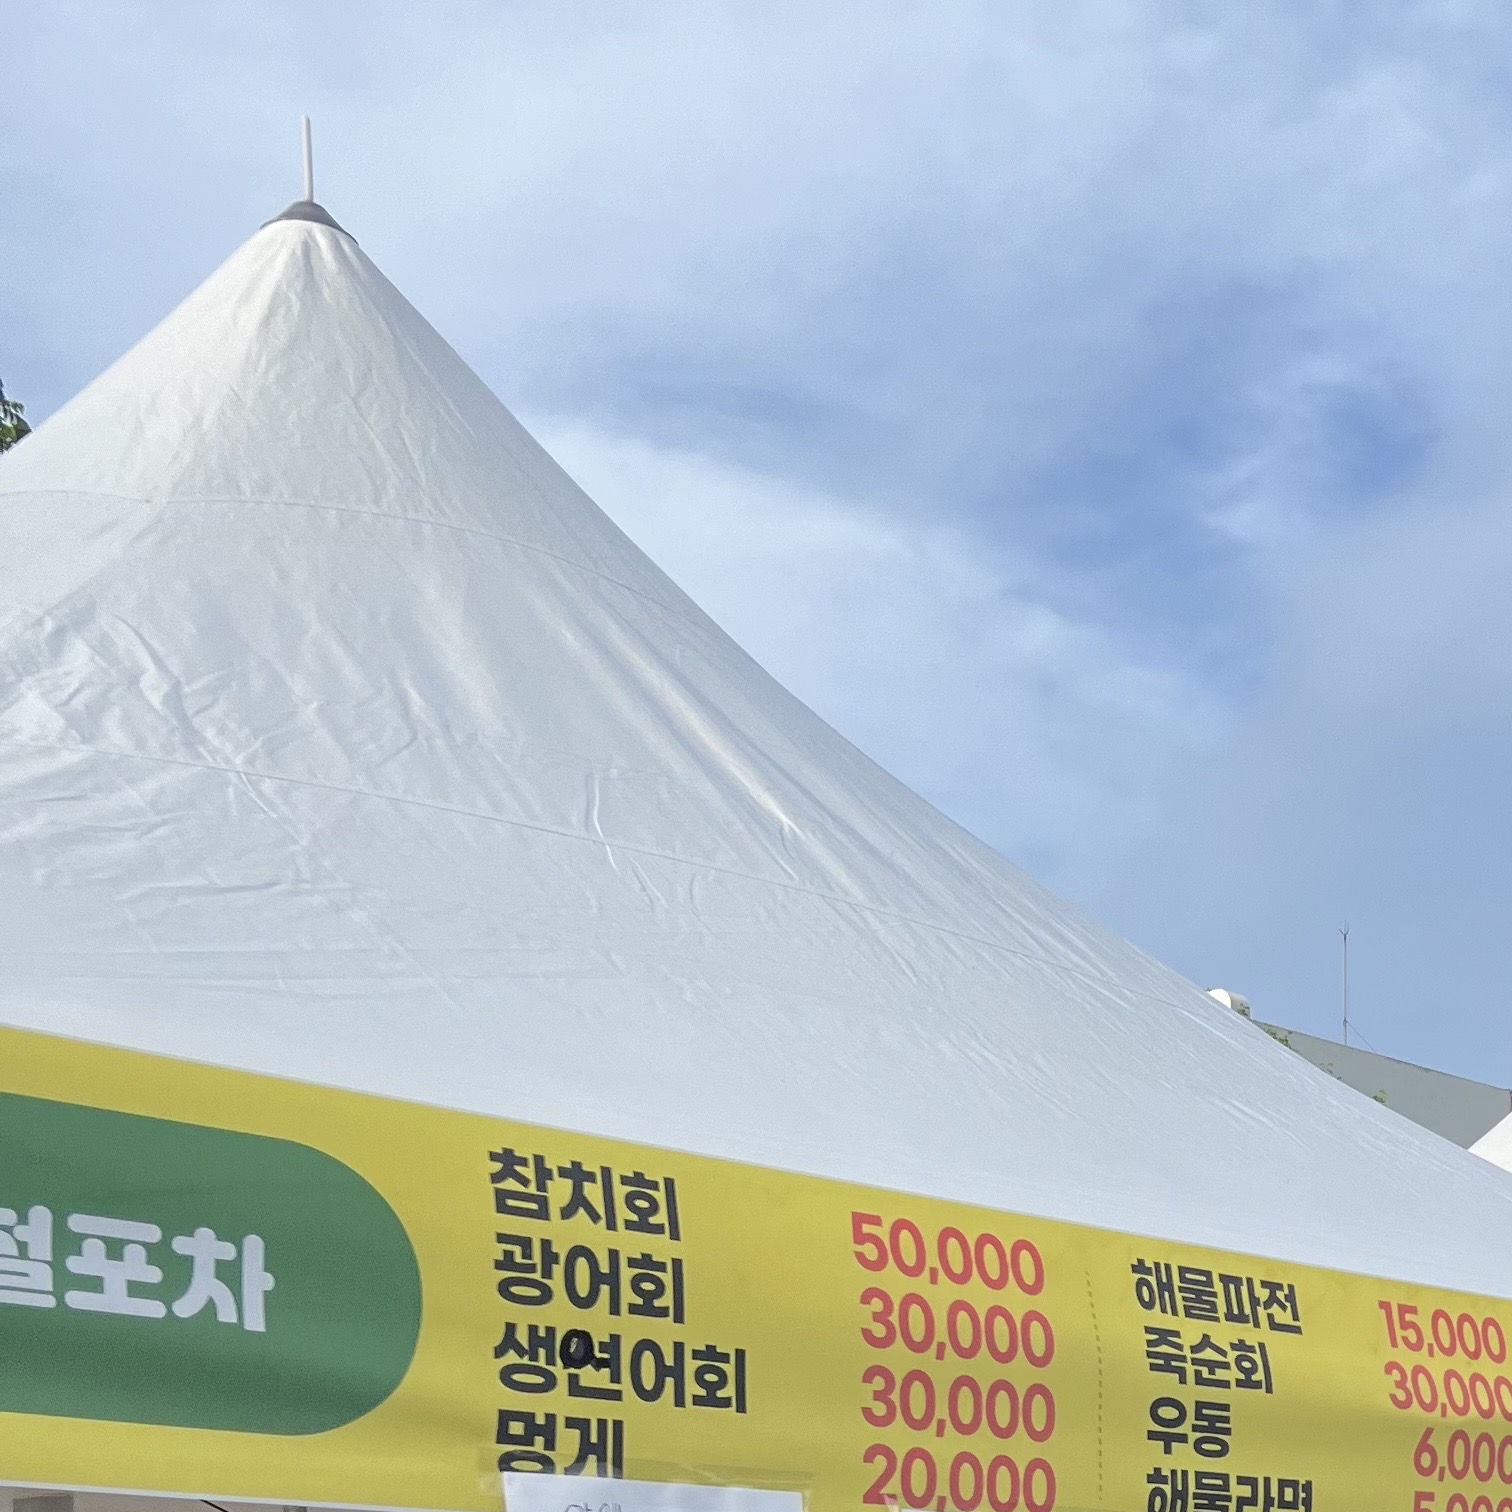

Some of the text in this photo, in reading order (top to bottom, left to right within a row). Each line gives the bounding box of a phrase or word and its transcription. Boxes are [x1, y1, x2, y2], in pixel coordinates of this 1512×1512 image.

[488, 1148, 1046, 1296] 참치회 50,000
[493, 1231, 1055, 1369] 광어회 30,000
[1130, 1257, 1507, 1365] 해물파전 15,000
[1144, 1325, 1274, 1395] 죽순회
[860, 1364, 1056, 1443] 30,000
[1145, 1395, 1233, 1459] 우동
[494, 1411, 625, 1479] 멍게
